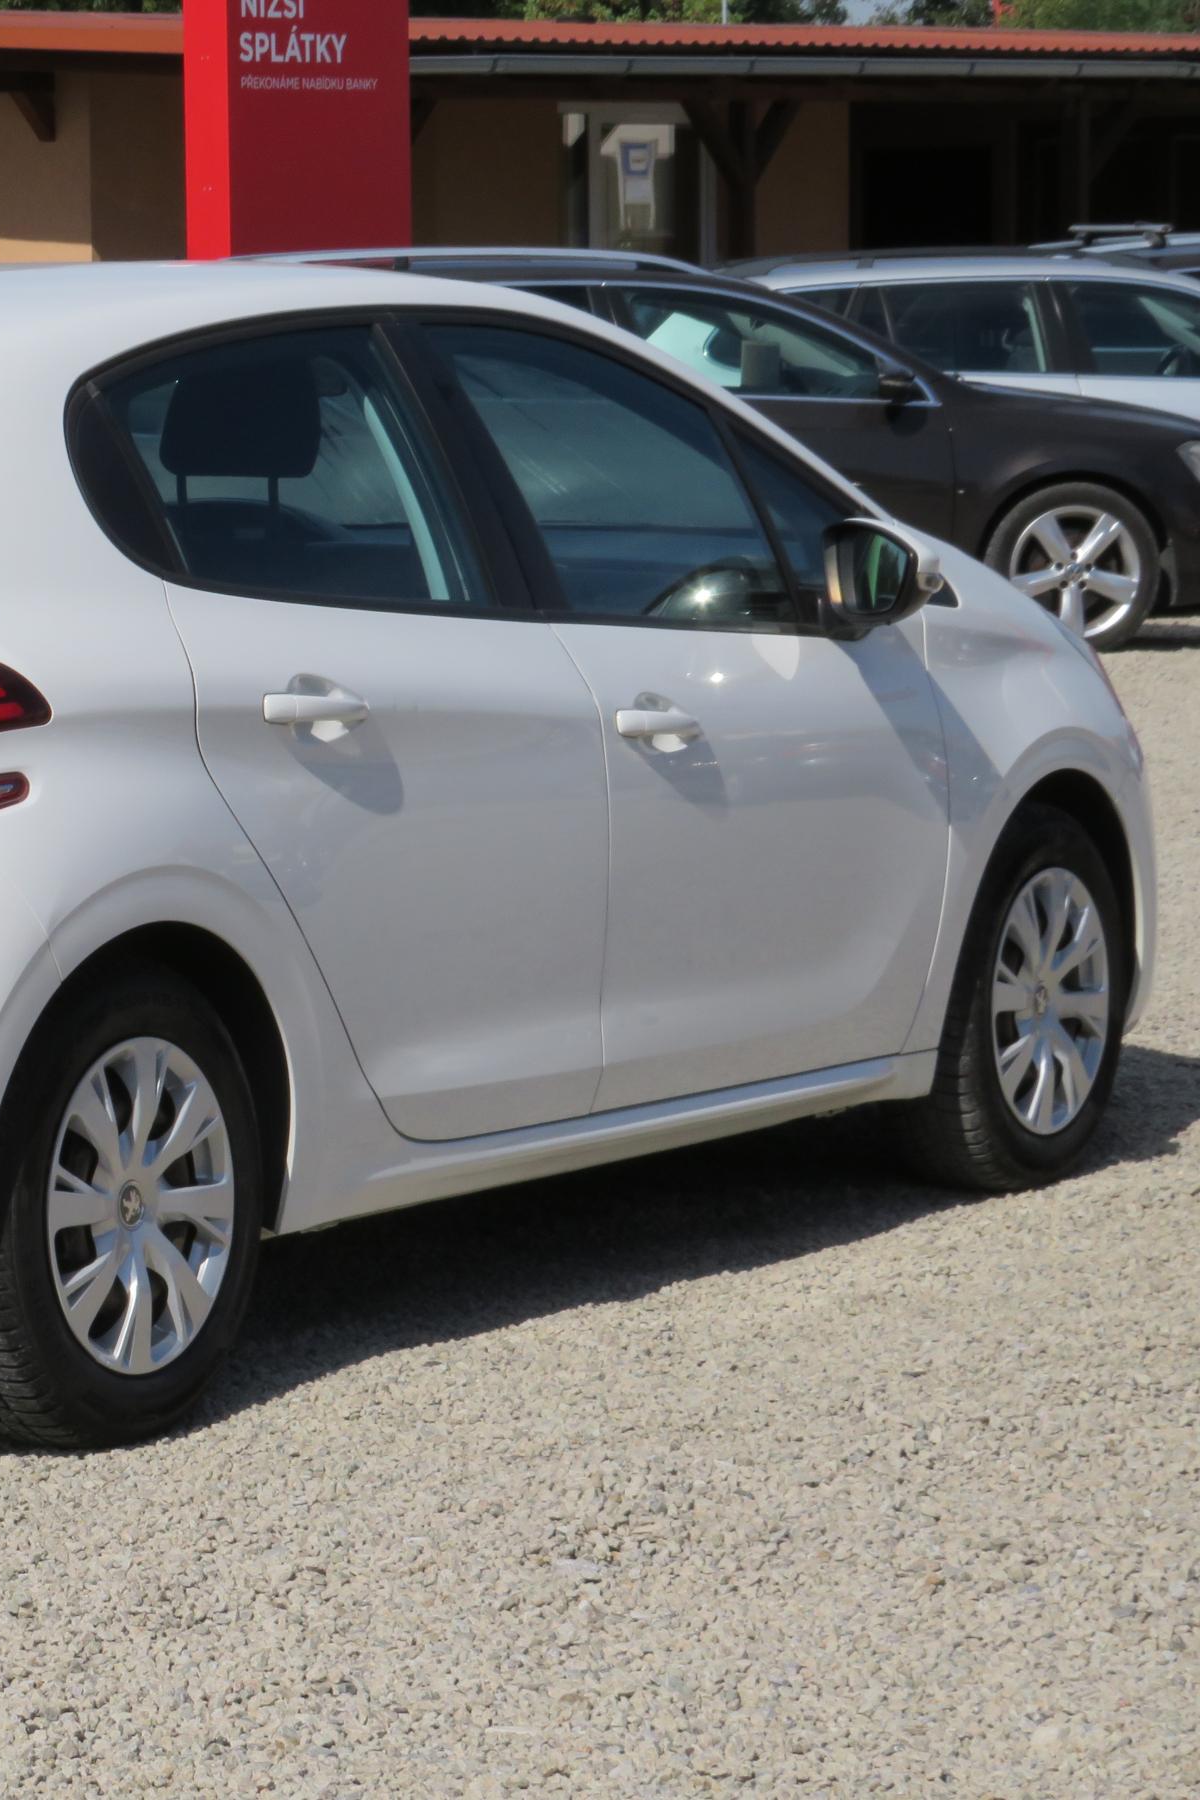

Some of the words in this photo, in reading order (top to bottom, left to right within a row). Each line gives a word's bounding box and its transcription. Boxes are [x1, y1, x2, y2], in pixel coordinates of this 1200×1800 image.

[239, 25, 347, 63] SPLÁTKY
[240, 74, 300, 90] PŘEKONÁME
[302, 76, 344, 90] NABÍDKU
[346, 78, 378, 90] BANKY
